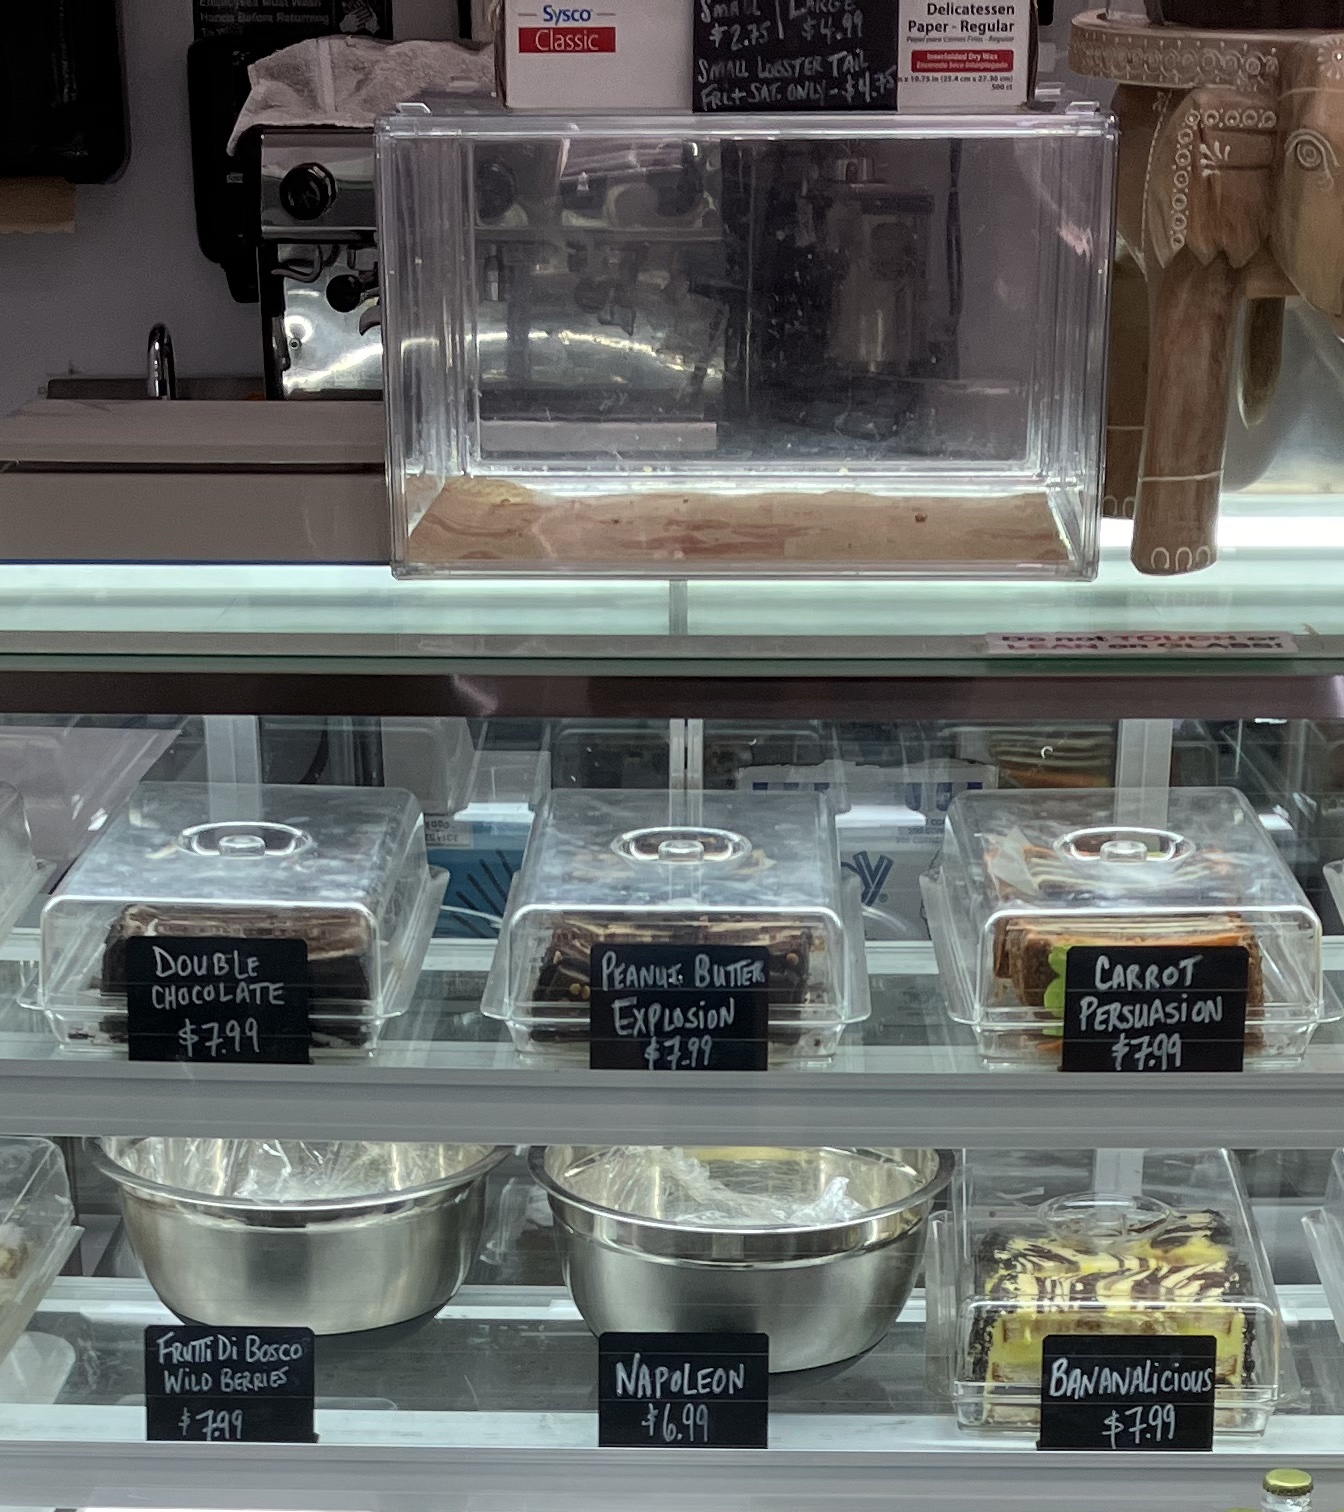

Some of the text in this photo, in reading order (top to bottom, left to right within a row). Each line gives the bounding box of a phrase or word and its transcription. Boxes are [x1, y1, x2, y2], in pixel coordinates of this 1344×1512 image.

[543, 5, 592, 26] Sysco
[927, 2, 1015, 15] Delicatessen
[535, 28, 600, 51] Classic
[709, 21, 772, 52] $2.75
[801, 9, 864, 45] $4.99
[908, 20, 949, 35] Paper
[960, 18, 1015, 35] Regular
[757, 55, 824, 79] LOBSTER
[786, 80, 826, 106] ONLY
[153, 945, 259, 980] DOUBLE
[601, 952, 767, 989] PEANUT BUTTER
[1093, 955, 1205, 991] CARROT
[151, 979, 285, 1010] CHOCOLATE
[178, 1017, 260, 1057] $7.99
[643, 1035, 712, 1071] $7.99
[1110, 1033, 1182, 1071] $7.99
[244, 1335, 303, 1362] BOSCO
[615, 1353, 745, 1399] NAPOLEON
[178, 1407, 242, 1441] $7.99
[641, 1403, 709, 1442] $6.99
[1102, 1402, 1177, 1449] $7.99
